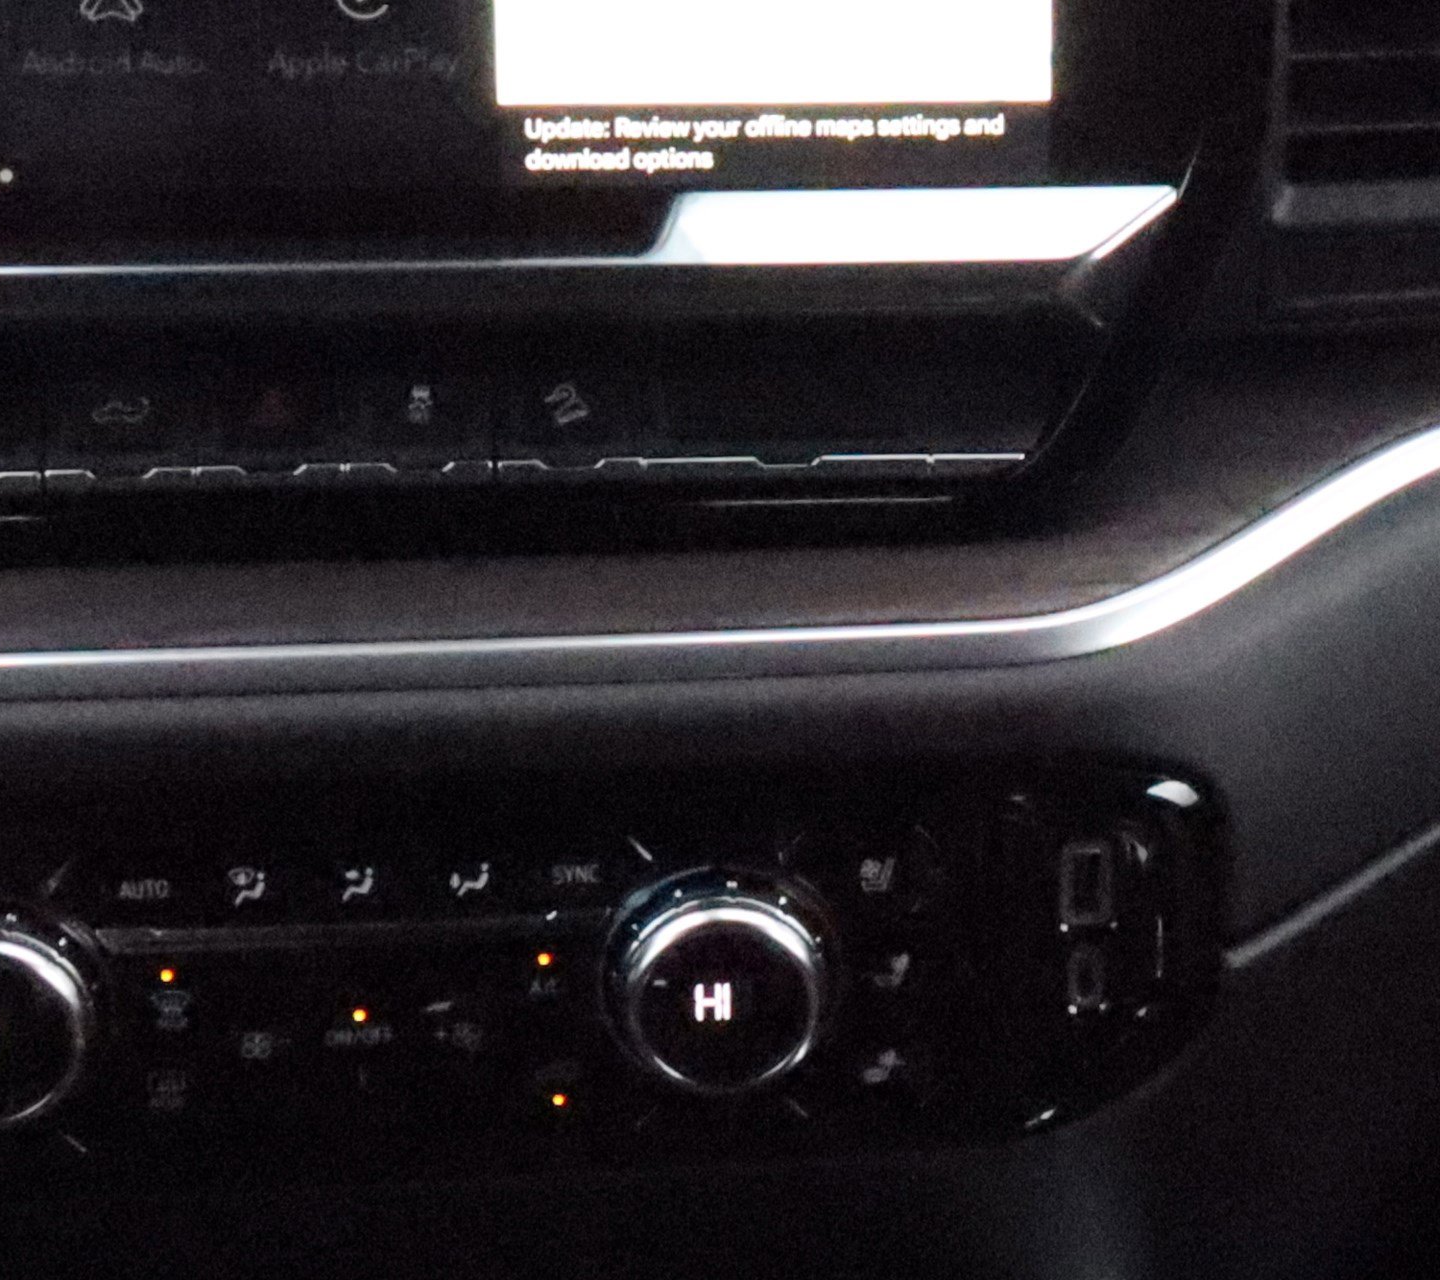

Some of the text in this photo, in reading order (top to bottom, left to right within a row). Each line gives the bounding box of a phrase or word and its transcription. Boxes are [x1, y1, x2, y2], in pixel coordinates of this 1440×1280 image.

[525, 113, 1005, 142] Update: Review your offline maps settings and
[525, 147, 713, 175] download options
[119, 878, 170, 901] AUTO
[692, 982, 733, 1022] HI
